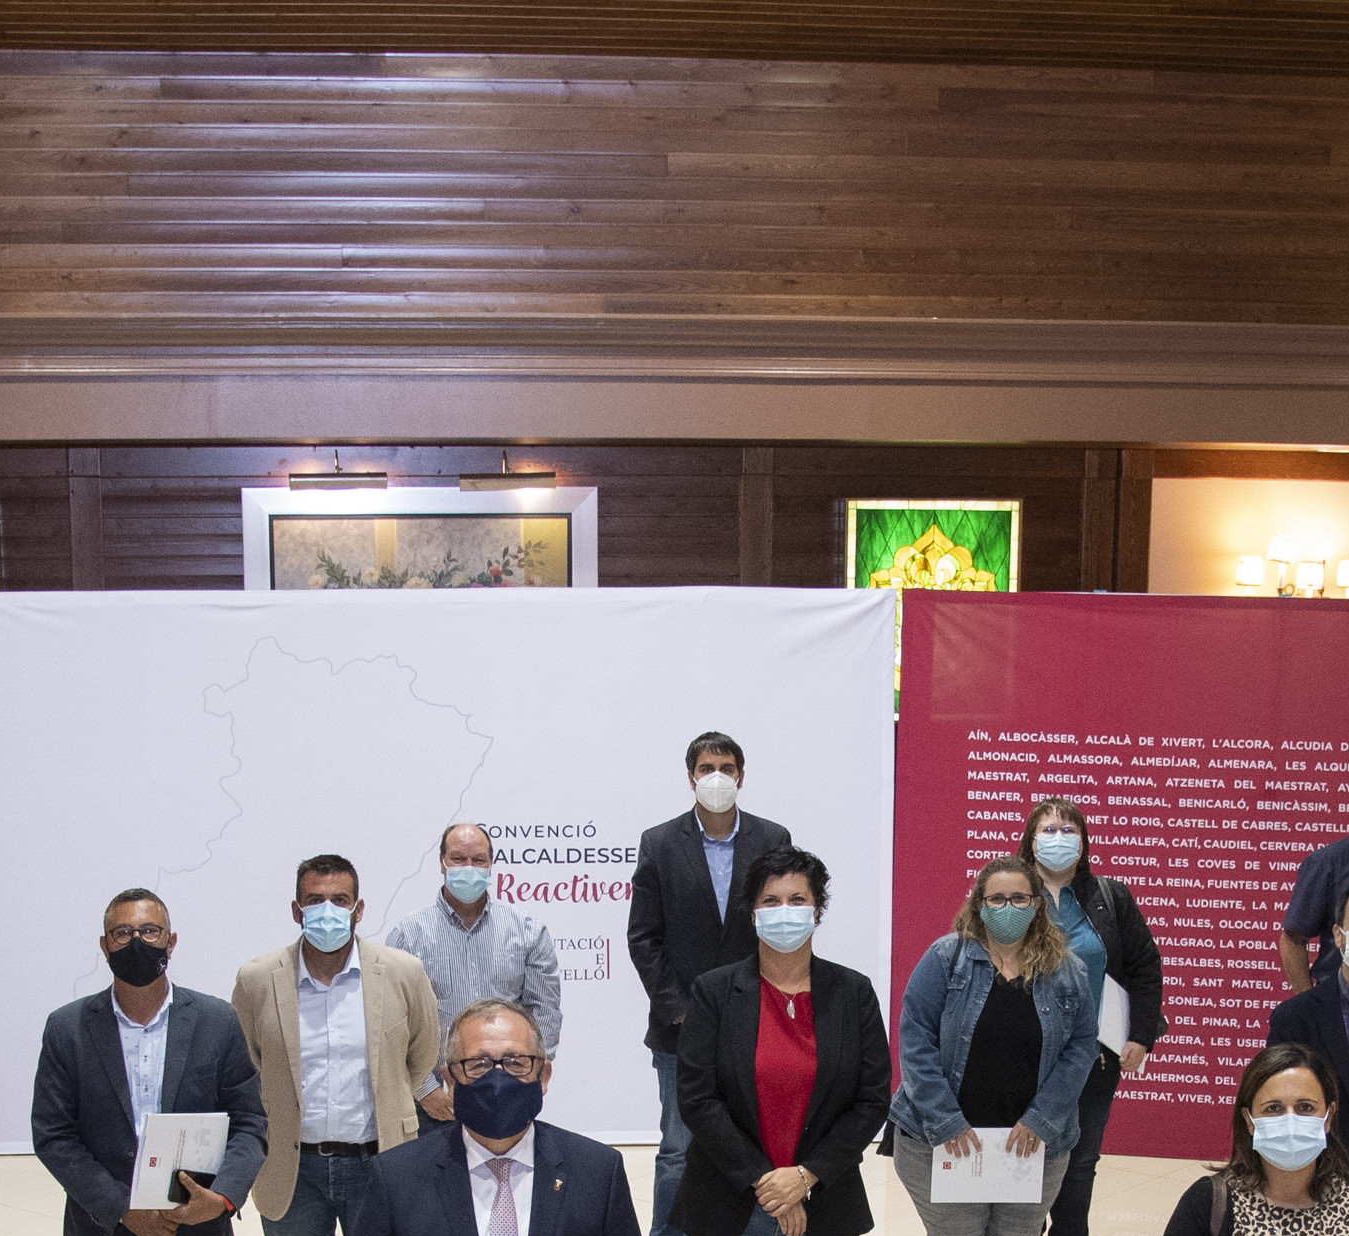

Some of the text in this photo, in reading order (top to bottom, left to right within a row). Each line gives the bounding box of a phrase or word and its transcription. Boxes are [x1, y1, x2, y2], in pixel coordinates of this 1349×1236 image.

[1138, 736, 1155, 747] DE
[1161, 737, 1206, 749] XIVERT,
[1280, 740, 1334, 751] ALCUDIA
[967, 750, 1040, 764] ALMONACID,
[1047, 753, 1123, 767] ALMASSORA,
[1207, 758, 1277, 772] ALMENARA,
[1285, 760, 1307, 771] LES
[967, 770, 1030, 784] MAESTRAT,
[1037, 773, 1098, 786] ARGELITA,
[1105, 775, 1158, 788] ARTANA,
[1165, 777, 1226, 789] ATZENETA
[1233, 779, 1257, 790] DEL
[1264, 780, 1329, 793] MAESTRAT,
[967, 790, 1024, 804] BENAFER,
[1107, 795, 1172, 809] BENASSAL,
[966, 810, 1025, 823] CABANES,
[1131, 816, 1164, 829] ROIG,
[1167, 817, 1219, 829] CASTELL
[1241, 820, 1292, 833] CABRES,
[966, 829, 1009, 843] PLANA,
[1087, 834, 1170, 849] VILLAMALEFA,
[1203, 839, 1258, 852] CAUDIEL,
[1259, 840, 1315, 852] CERVERA
[1110, 855, 1237, 870] COSTUR, LES COVES
[1165, 877, 1260, 891] REINA, FUENTES
[1185, 898, 1246, 911] LUDIENTE,
[1173, 917, 1268, 931] NULES, OLOCAU
[1238, 939, 1278, 951] POBLA
[595, 953, 605, 965] E
[1227, 959, 1281, 972] ROSSELL,
[560, 965, 605, 981] ELLÓ
[1192, 977, 1274, 991] SANT MATEU,
[1167, 995, 1243, 1009] SONEJA, SOT
[1202, 1016, 1241, 1029] PINAR,
[1120, 1070, 1209, 1085] VILLAHERMOSA
[1113, 1089, 1215, 1105] MAESTRAT, VIVER,
